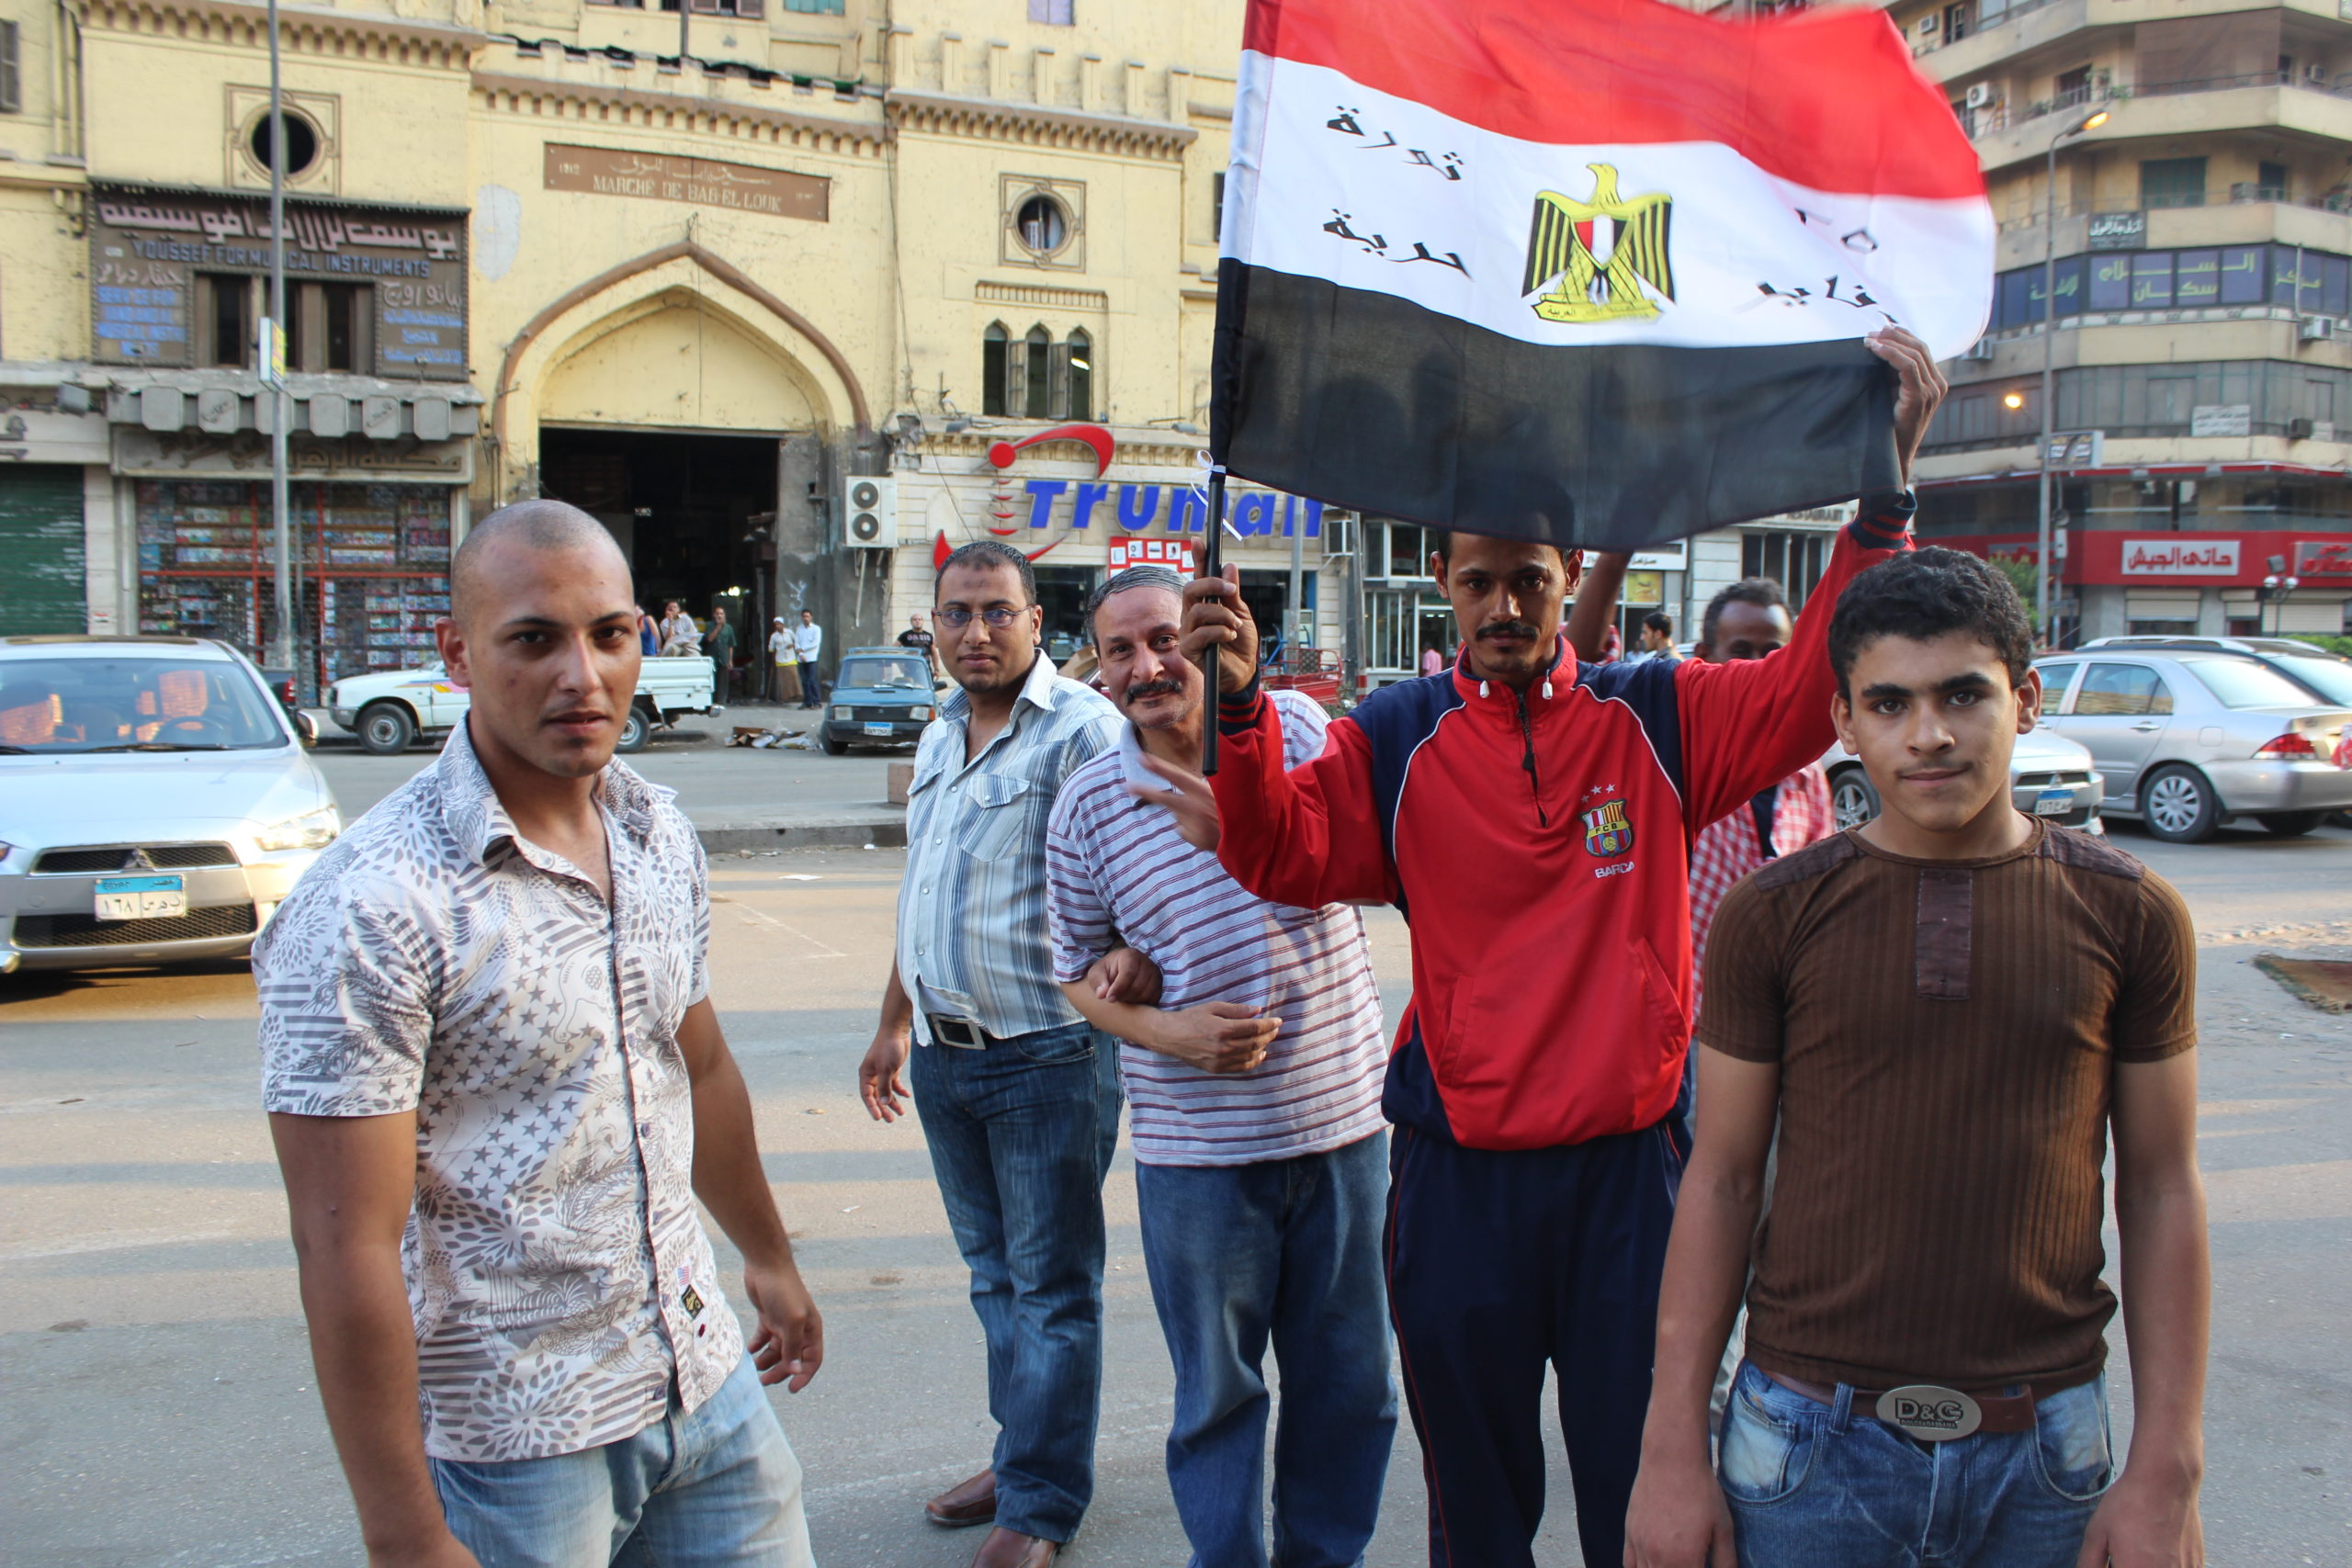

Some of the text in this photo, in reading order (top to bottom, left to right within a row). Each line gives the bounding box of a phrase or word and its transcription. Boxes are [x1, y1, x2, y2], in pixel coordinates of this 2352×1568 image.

[1327, 106, 1464, 181] ثورة
[662, 181, 682, 199] DE
[743, 193, 782, 214] LOUK
[132, 240, 432, 278] YOUSSEF FOR MUICAL INSTRUMENTS
[1323, 209, 1476, 282] حرية
[2098, 252, 2256, 281] السلام
[1024, 479, 1324, 539] Truman
[2128, 547, 2181, 570] الجيش
[1595, 822, 1618, 834] FCB
[104, 898, 133, 913] ١٦٨
[1894, 1397, 1964, 1423] D&G
